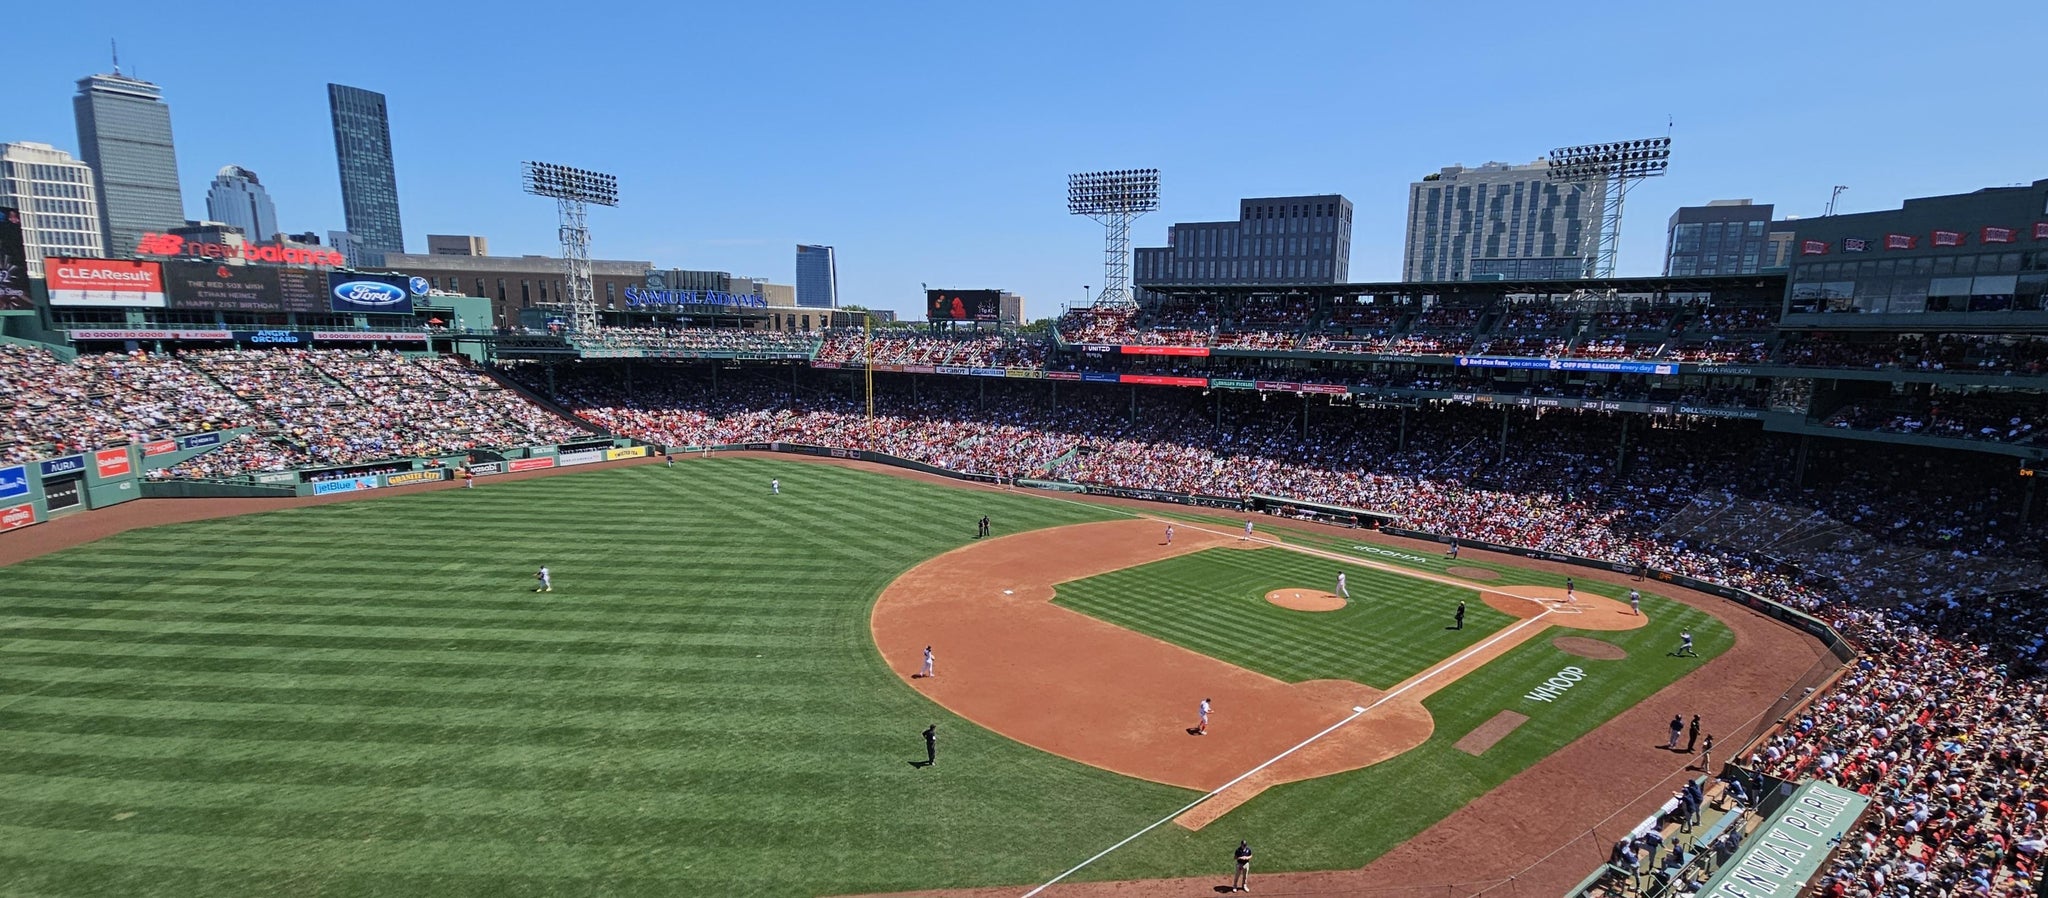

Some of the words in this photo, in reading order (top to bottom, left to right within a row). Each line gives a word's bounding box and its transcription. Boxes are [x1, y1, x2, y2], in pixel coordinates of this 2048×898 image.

[188, 241, 239, 258] new
[242, 239, 343, 267] balance
[57, 267, 152, 281] CLEAResult
[349, 284, 391, 301] Ford
[624, 287, 702, 307] SAMUEL
[704, 289, 767, 309] ADAMS
[388, 471, 422, 484] GRANITE
[423, 470, 439, 479] CITY
[319, 481, 350, 493] jetBlue
[1354, 545, 1426, 563] WHOOP
[1524, 666, 1588, 703] WHOOP
[1782, 785, 1852, 837] PARK
